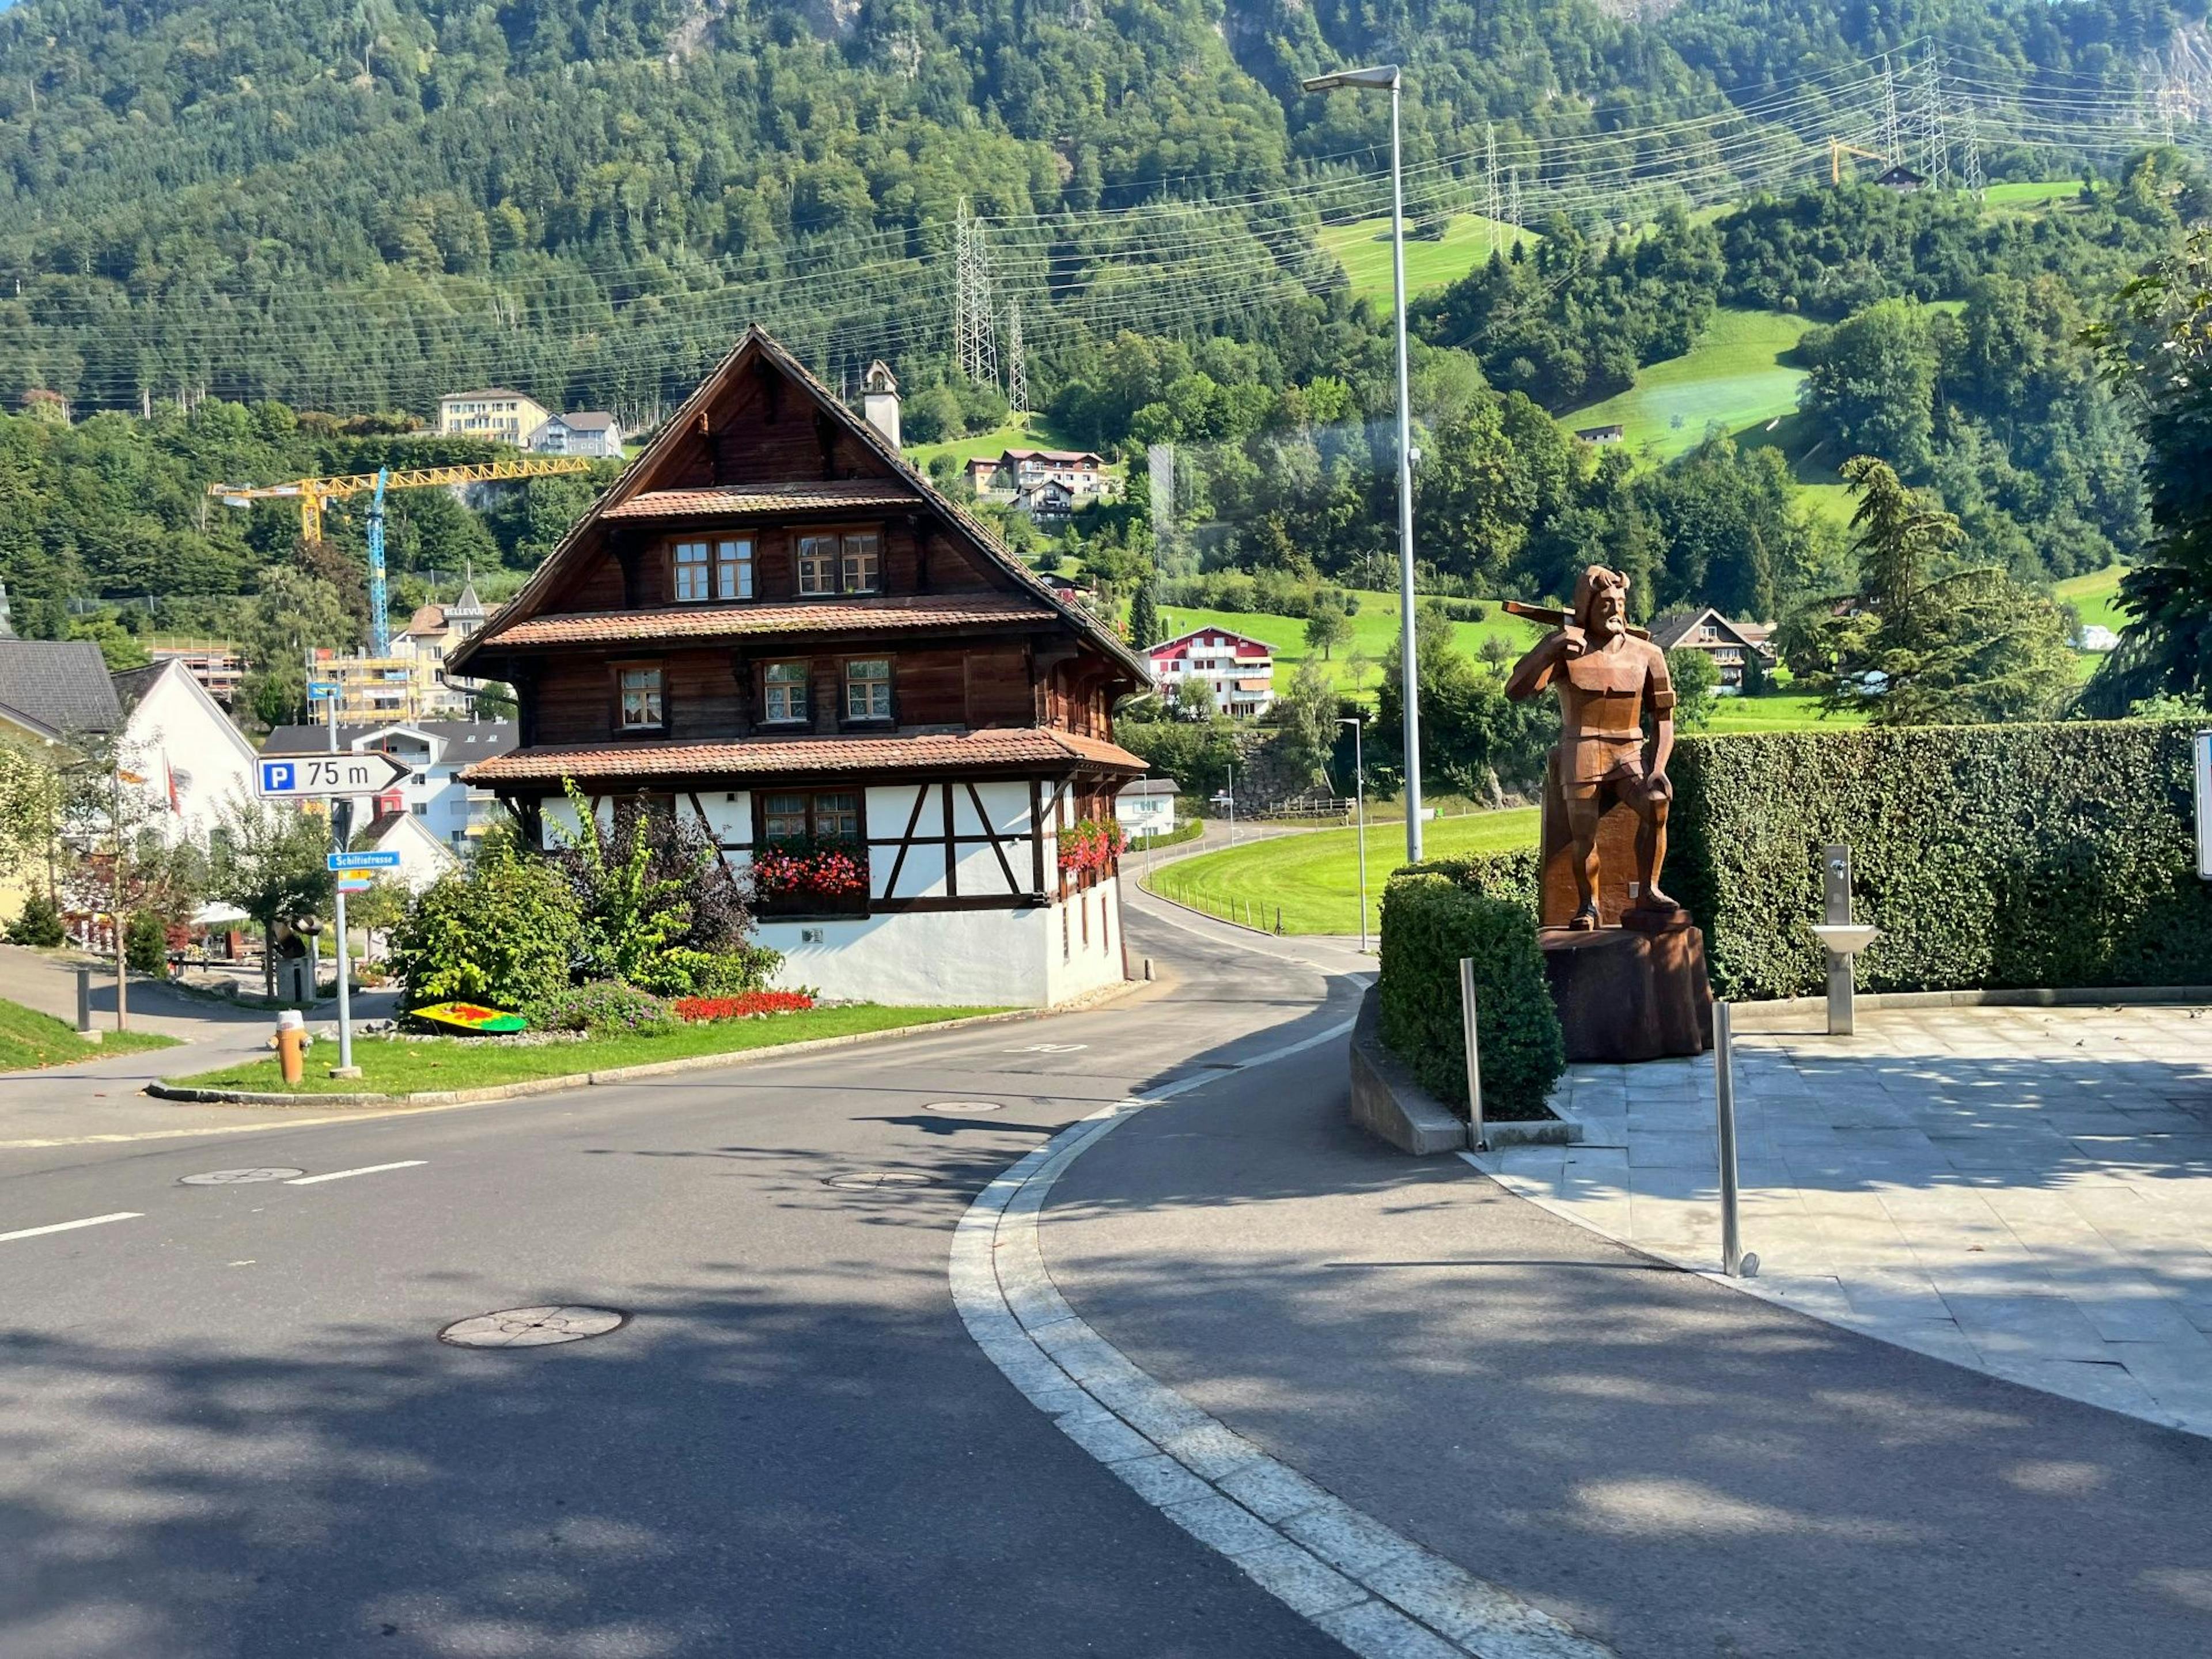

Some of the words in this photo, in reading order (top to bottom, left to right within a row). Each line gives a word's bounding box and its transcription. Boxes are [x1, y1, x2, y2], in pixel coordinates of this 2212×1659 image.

[272, 767, 287, 788] P
[308, 762, 339, 785] 75
[349, 767, 368, 783] m
[336, 855, 393, 866] Schiltistrasse
[1001, 1043, 1088, 1053] 30
